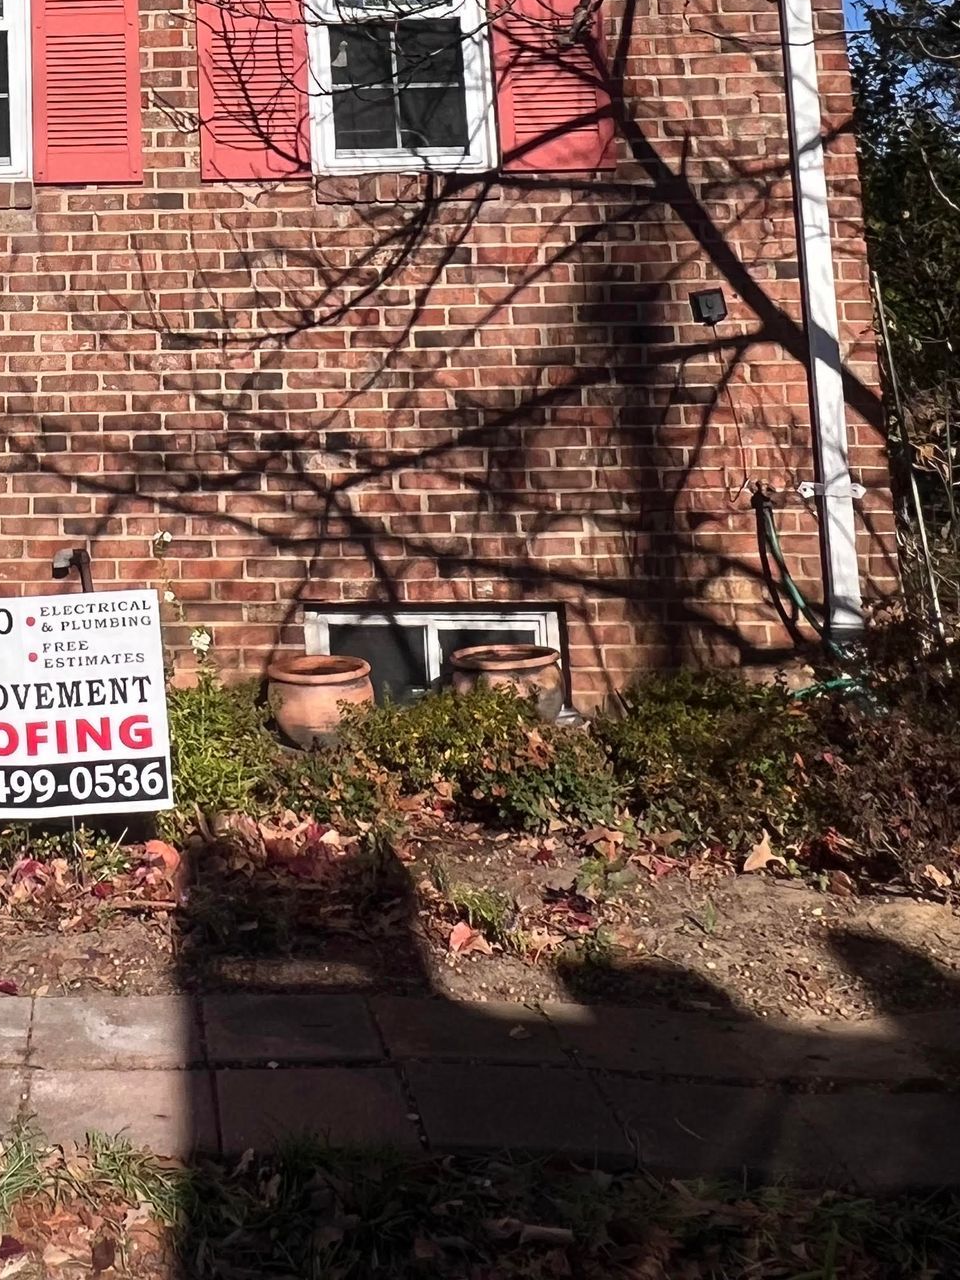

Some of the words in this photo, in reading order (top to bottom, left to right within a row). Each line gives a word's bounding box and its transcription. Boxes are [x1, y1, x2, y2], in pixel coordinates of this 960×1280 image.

[40, 600, 151, 617] ELECTRICAL
[41, 623, 53, 632] &
[61, 616, 151, 631] PLUMBING
[42, 641, 89, 653] FREE
[44, 653, 145, 669] ESTIMATES
